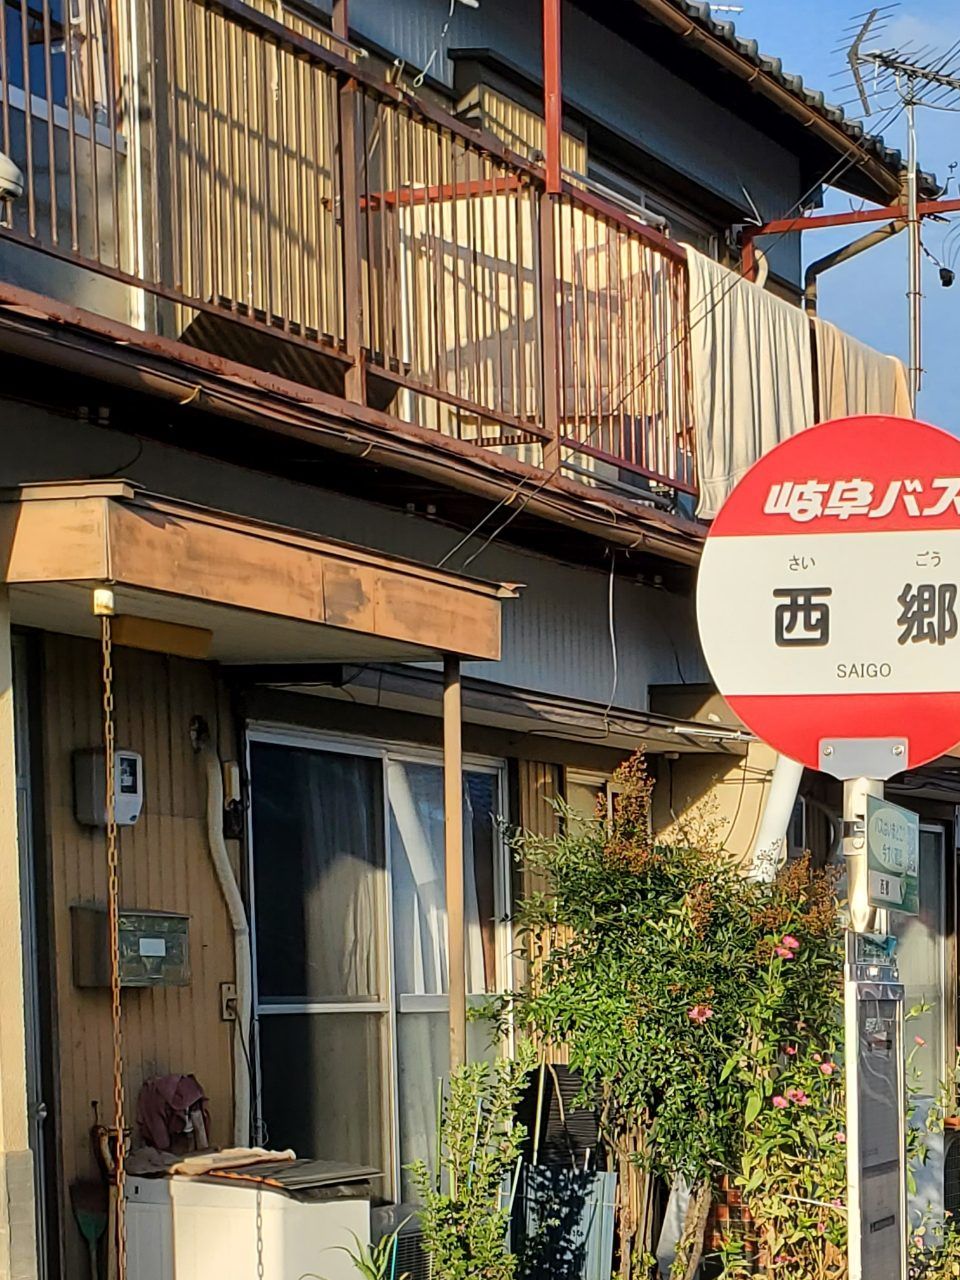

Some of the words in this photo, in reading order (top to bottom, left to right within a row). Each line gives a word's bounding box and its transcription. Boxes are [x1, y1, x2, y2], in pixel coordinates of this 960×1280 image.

[787, 554, 816, 572] さい
[914, 550, 943, 568] ごう
[772, 586, 833, 647] 西
[896, 582, 958, 646] 郷
[836, 662, 892, 679] SAIGO
